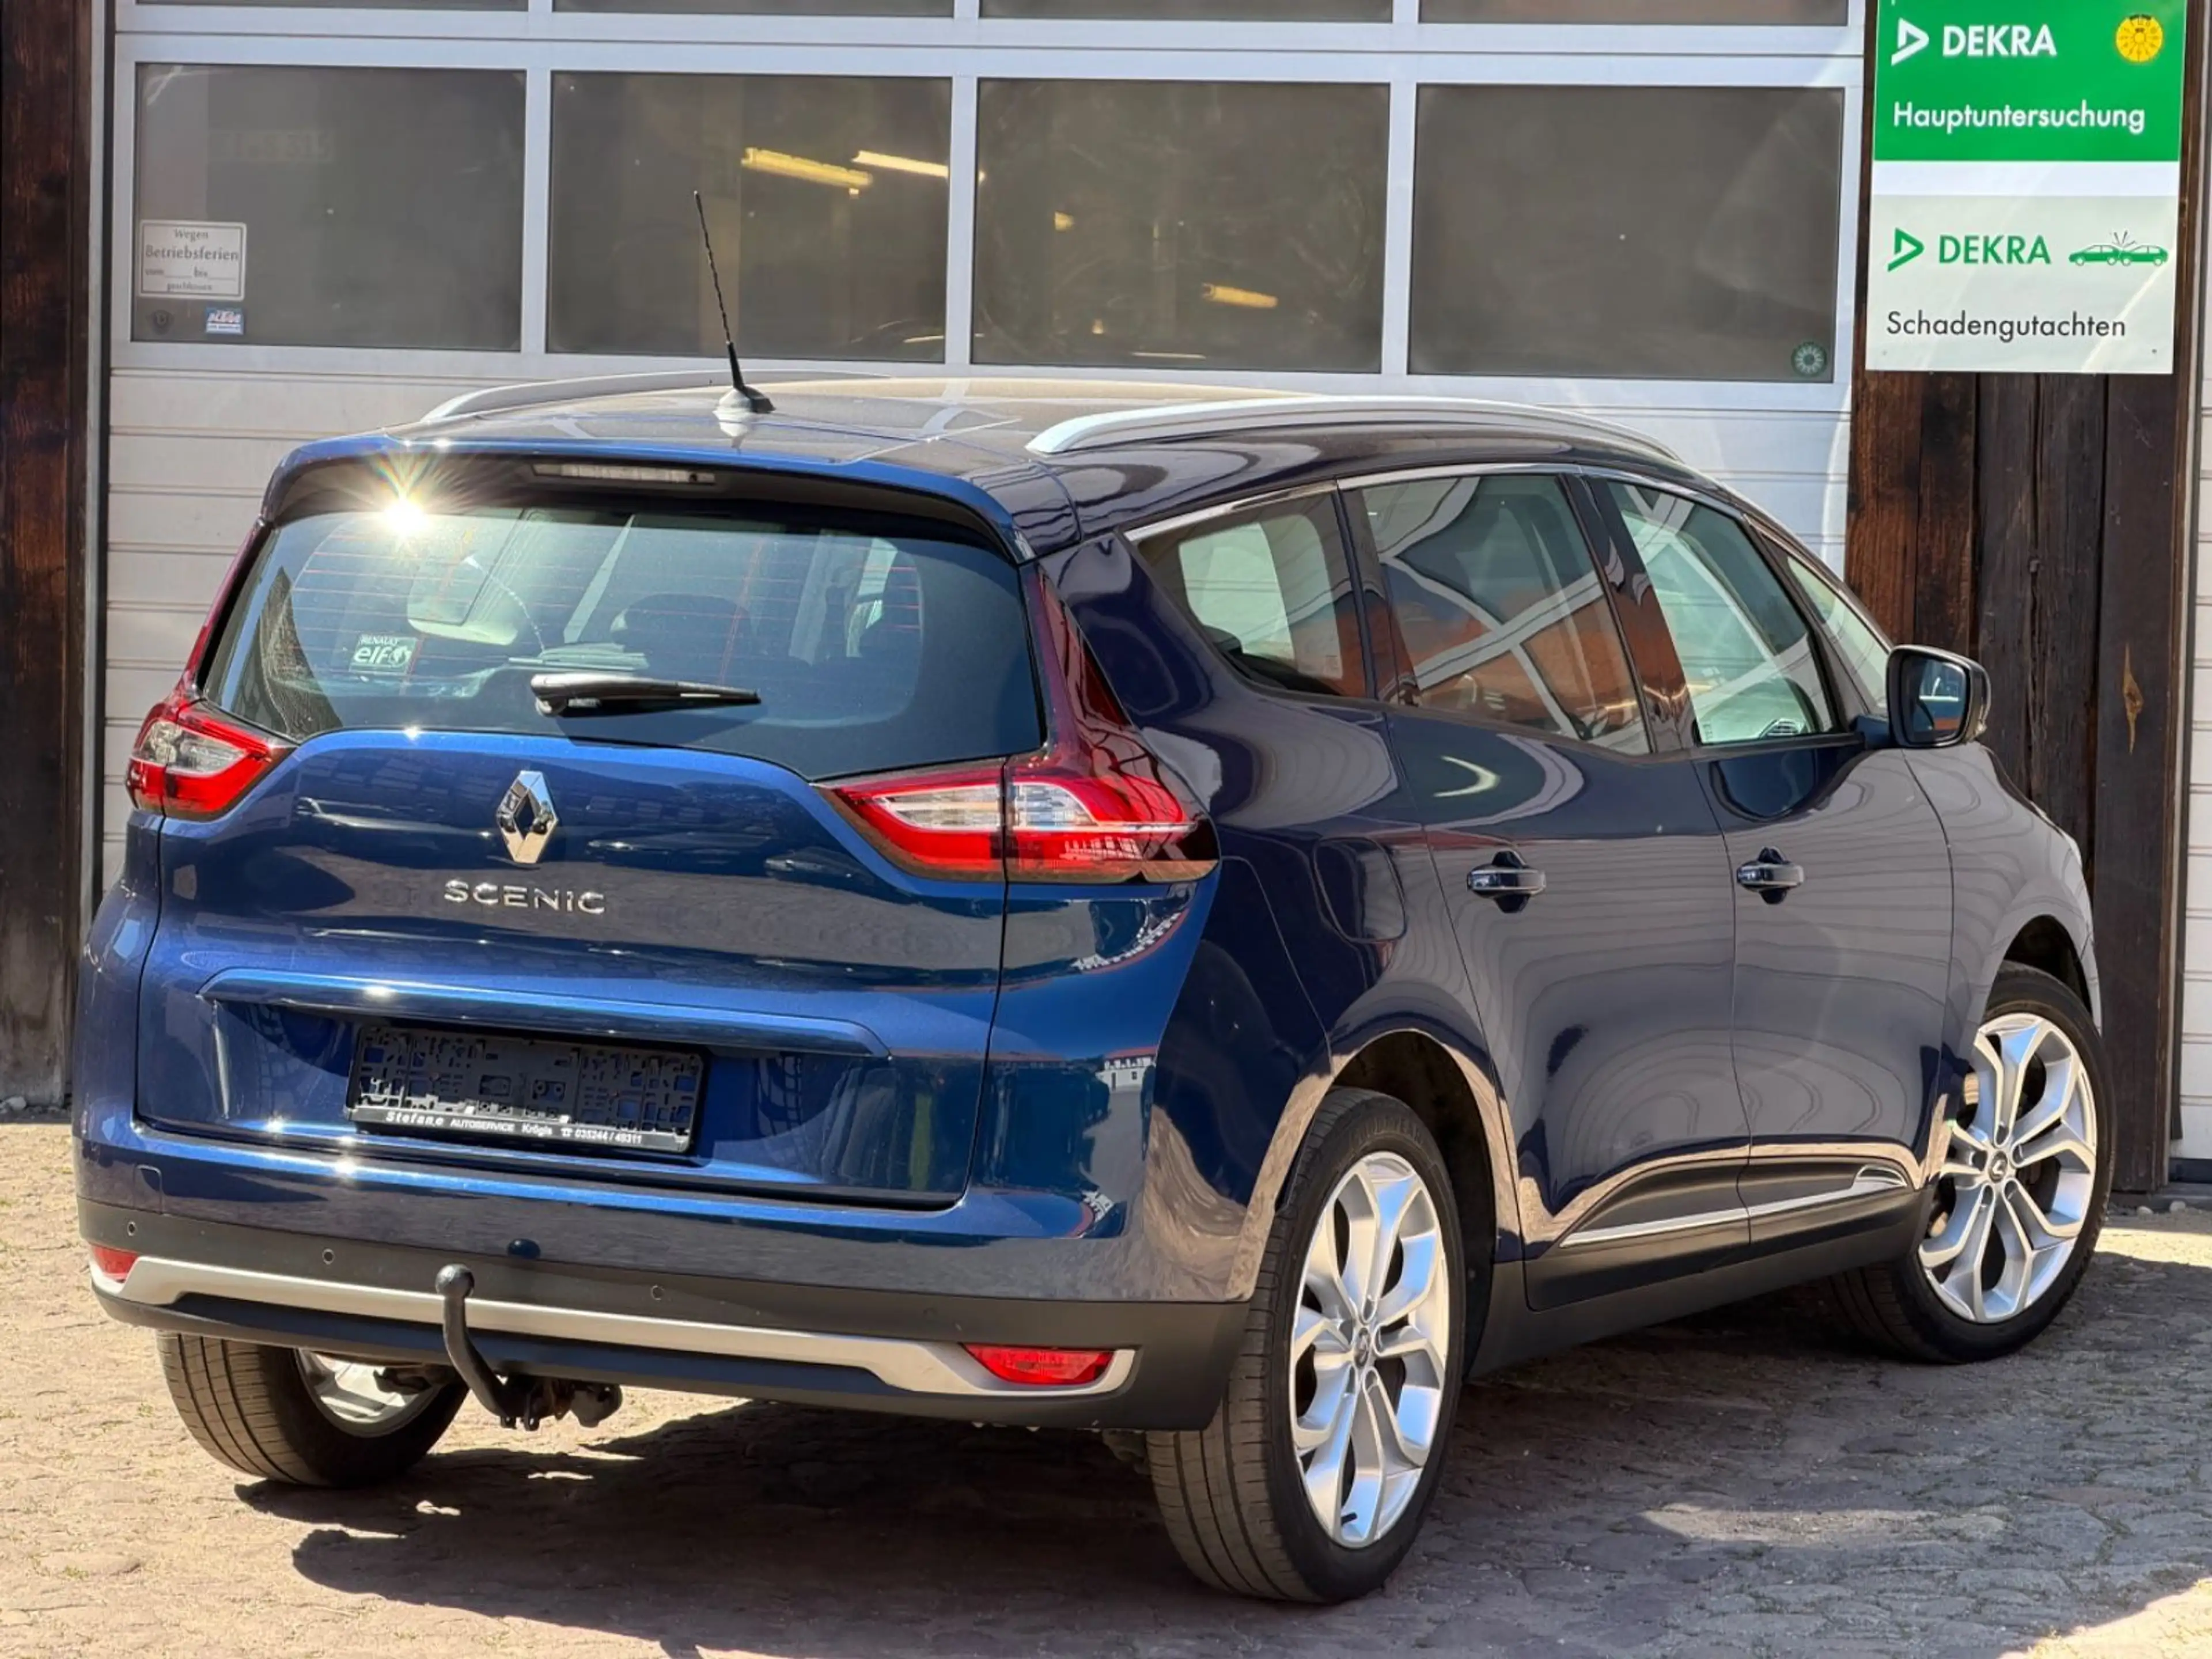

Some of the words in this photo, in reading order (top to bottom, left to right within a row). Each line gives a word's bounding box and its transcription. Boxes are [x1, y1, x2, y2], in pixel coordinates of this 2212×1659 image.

[1942, 24, 2058, 57] DEKRA
[1893, 100, 2146, 134] Hauptuntersuchung
[174, 228, 209, 243] Wegen
[1938, 235, 2051, 264] DEKRA
[145, 244, 238, 261] Betriebsferien
[1886, 309, 2126, 343] Schadengutachten
[353, 646, 392, 664] elf
[444, 879, 605, 915] SCENIC
[450, 1118, 516, 1132] AUTOSERVICE
